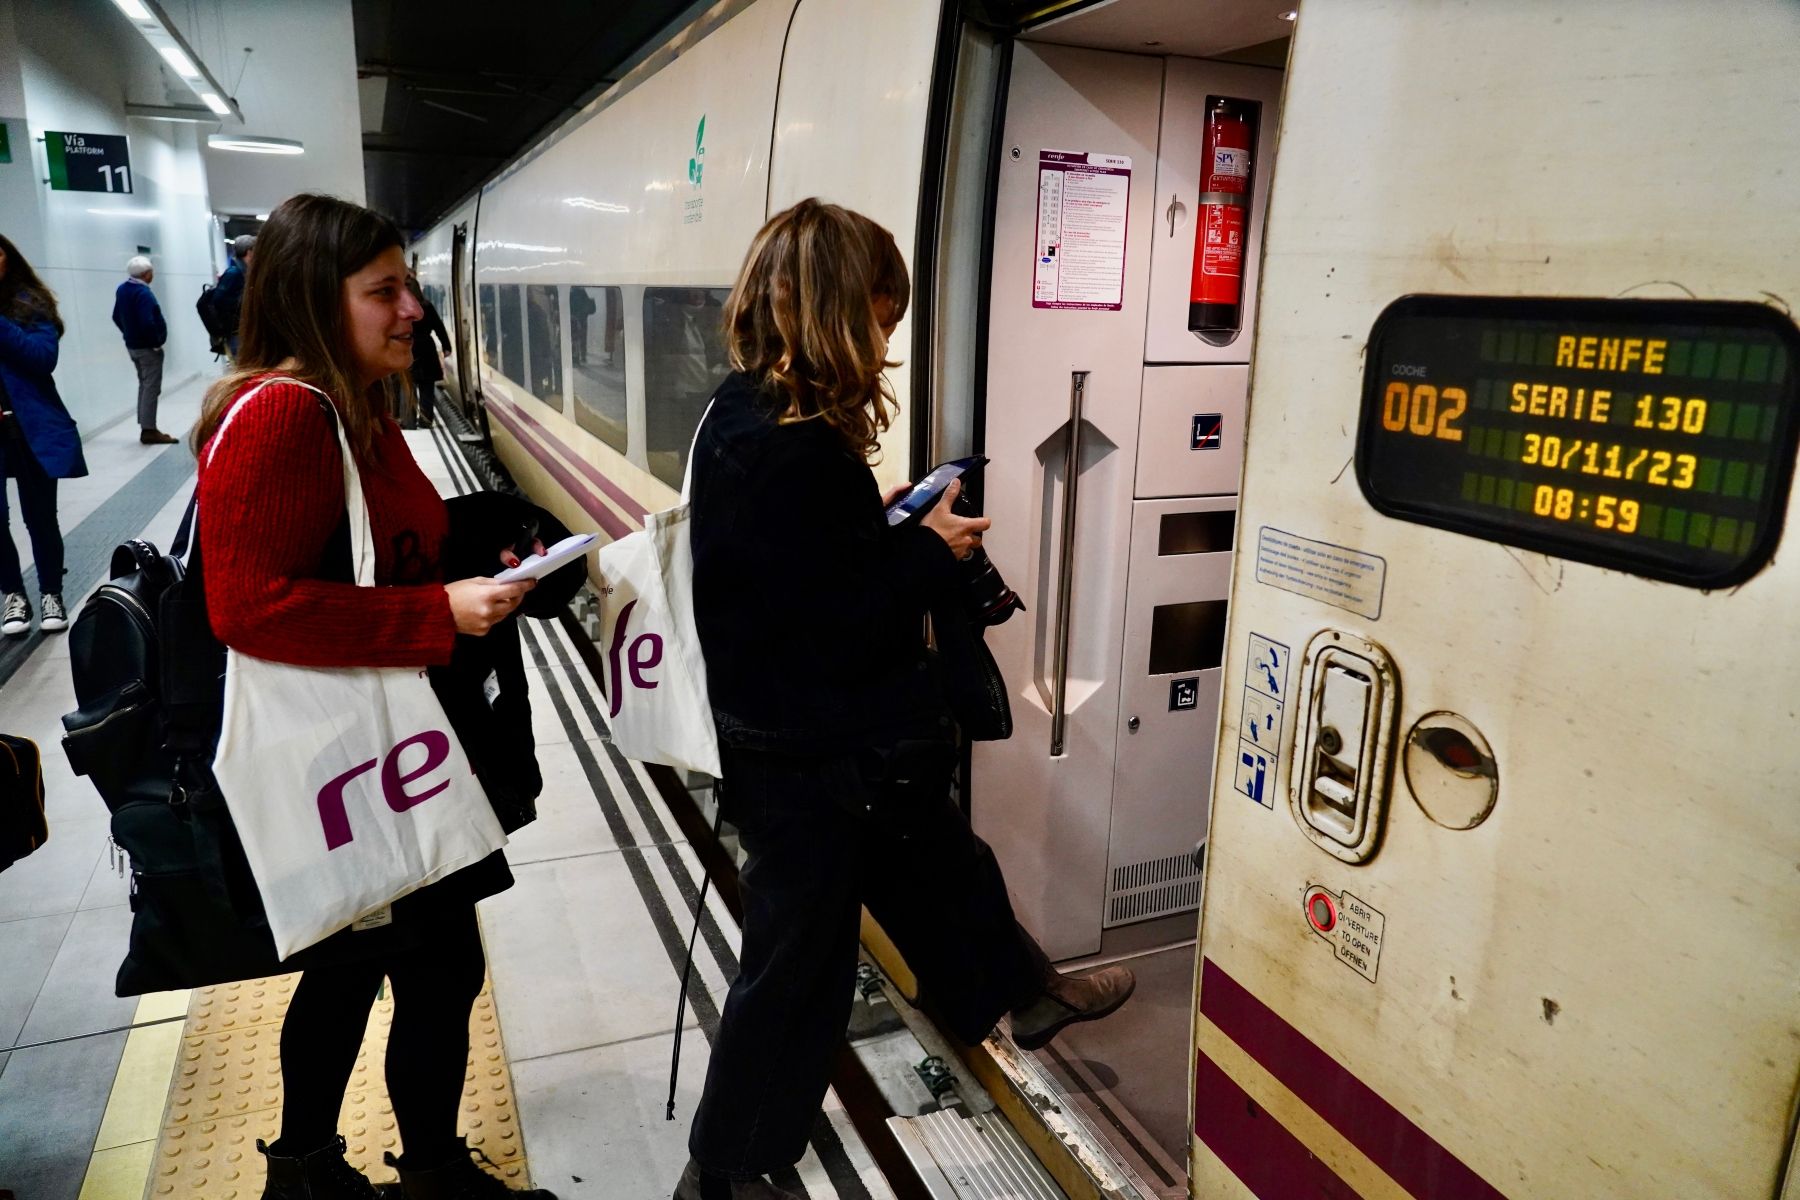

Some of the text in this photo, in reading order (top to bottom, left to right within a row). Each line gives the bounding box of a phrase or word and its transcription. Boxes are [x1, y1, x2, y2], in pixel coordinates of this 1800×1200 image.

[64, 134, 86, 147] Vía
[65, 146, 104, 155] PLATFORM
[1047, 153, 1065, 161] renfe
[1216, 153, 1236, 164] SPV
[98, 164, 130, 193] 11
[1555, 335, 1667, 375] RENFE
[1391, 364, 1427, 377] COCHE
[1383, 382, 1467, 441] 002
[1510, 383, 1707, 434] SERIE 130
[1522, 433, 1697, 490] 30/11/23
[1534, 485, 1640, 533] 08:59
[1350, 903, 1371, 922] ABRIR
[1342, 930, 1371, 956] TO OPEN
